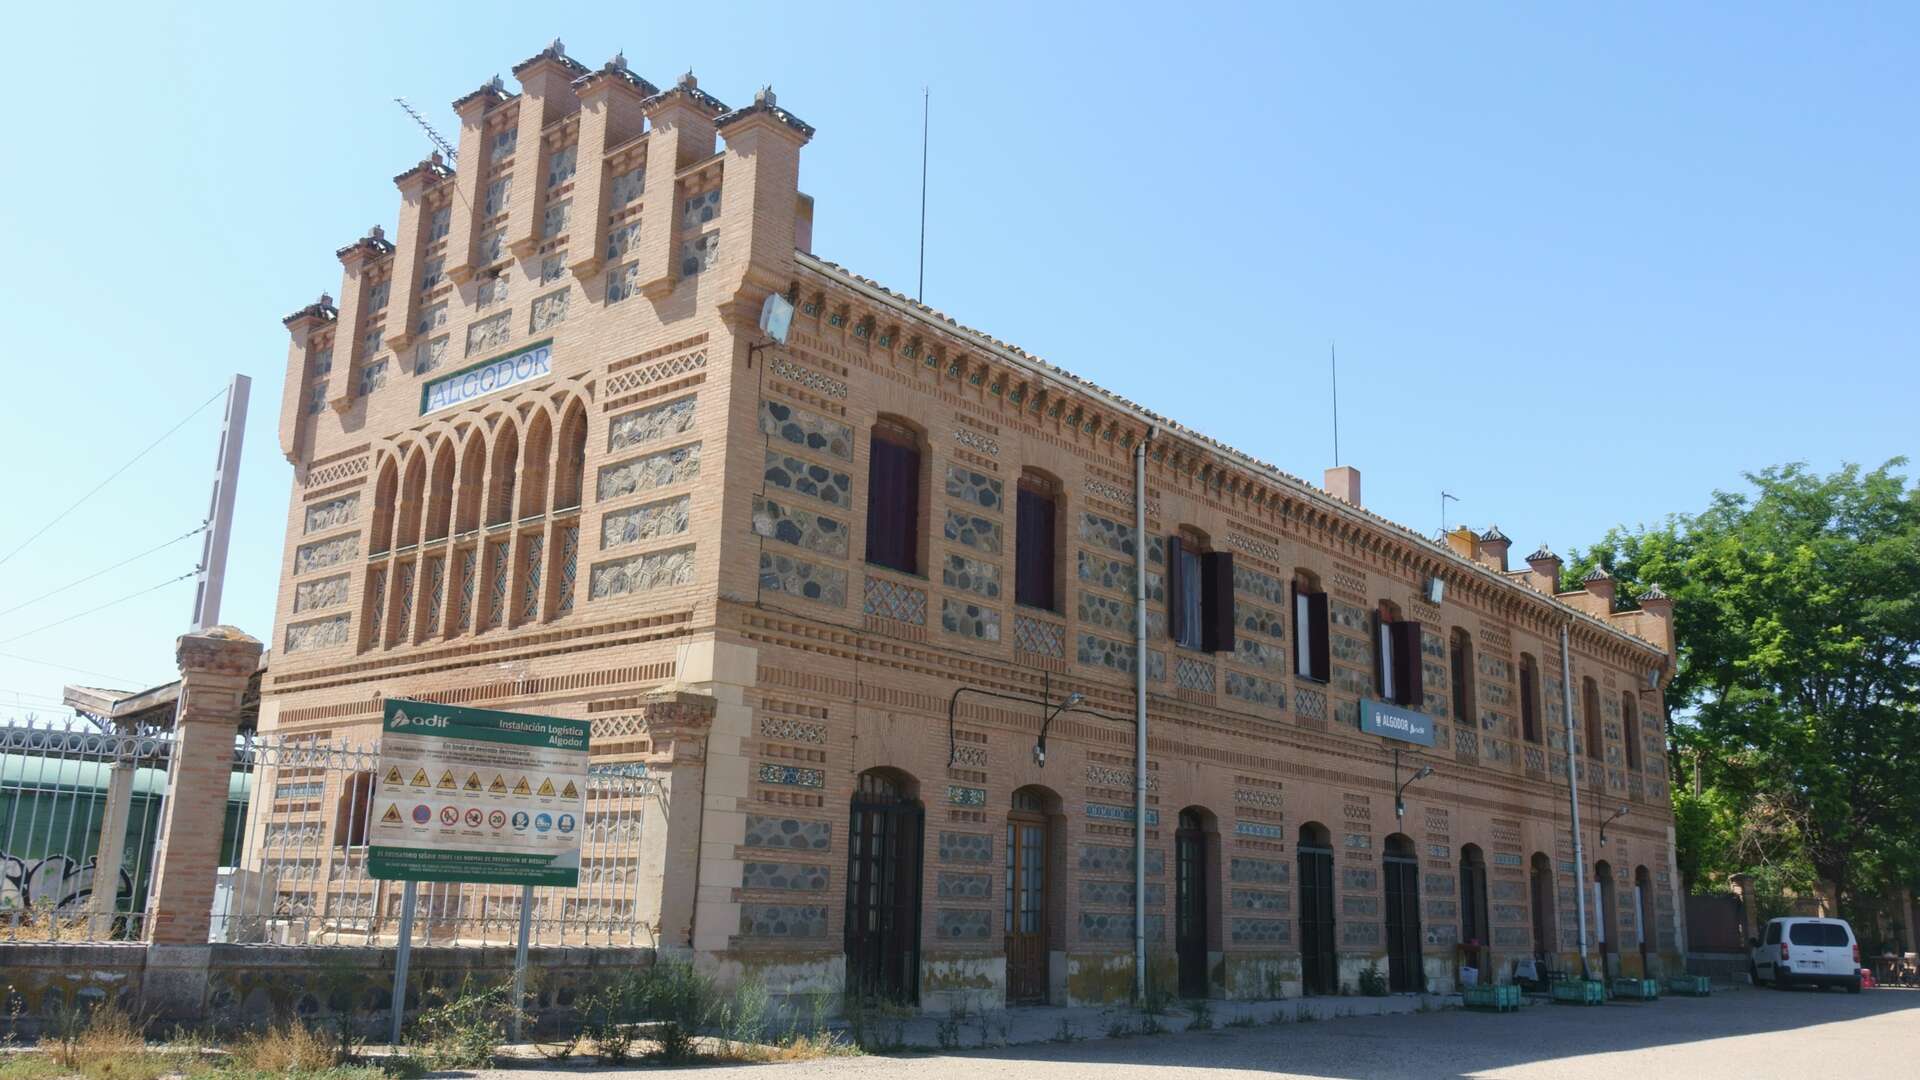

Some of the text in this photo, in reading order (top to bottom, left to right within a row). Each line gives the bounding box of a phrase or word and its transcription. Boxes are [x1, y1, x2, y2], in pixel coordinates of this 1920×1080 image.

[429, 348, 549, 411] ALGODOR
[412, 714, 450, 728] adif
[499, 719, 584, 737] Instalación Logística
[1382, 714, 1409, 731] ALGODOR
[548, 735, 583, 748] Algodor
